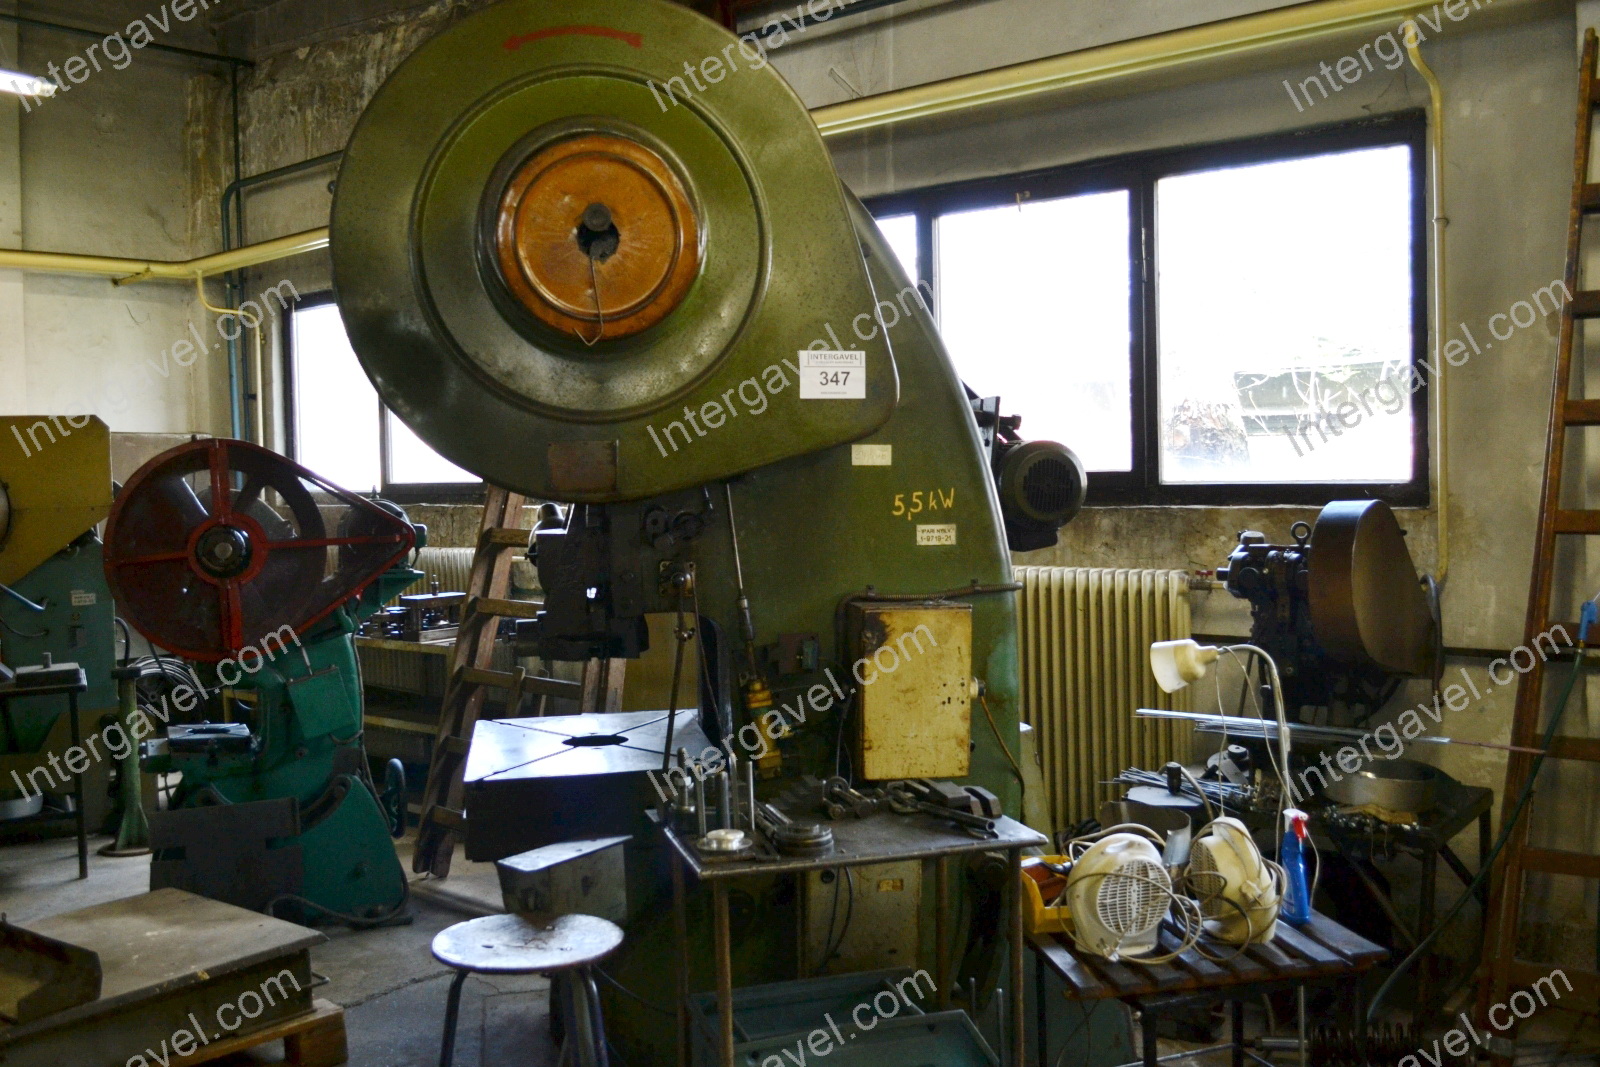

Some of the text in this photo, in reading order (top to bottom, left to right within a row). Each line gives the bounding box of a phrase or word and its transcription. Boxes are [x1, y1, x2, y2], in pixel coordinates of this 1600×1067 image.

[810, 353, 859, 361] INTERGAVEL
[819, 371, 850, 386] 347
[892, 487, 955, 520] 5,5 kW
